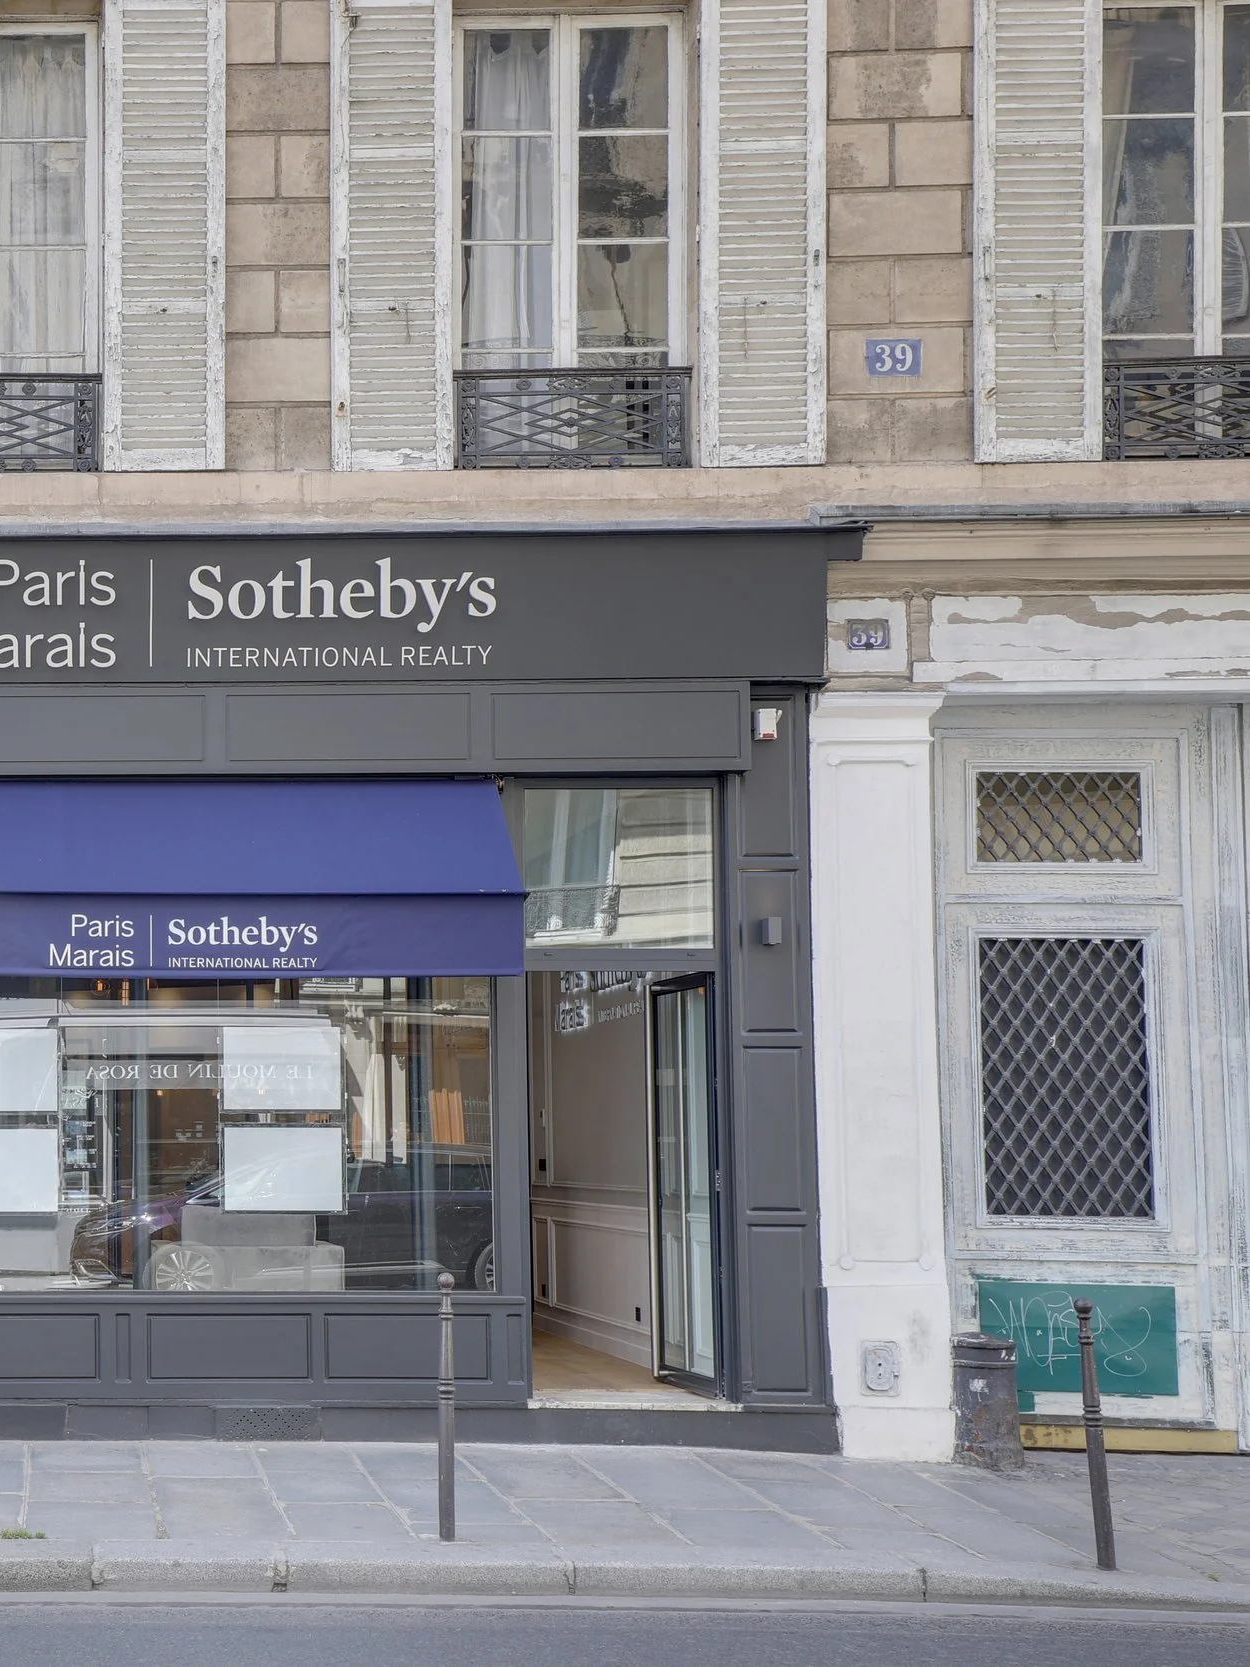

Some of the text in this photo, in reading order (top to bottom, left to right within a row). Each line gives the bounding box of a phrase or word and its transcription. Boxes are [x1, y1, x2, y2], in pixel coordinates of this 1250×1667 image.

[875, 343, 913, 372] 39
[187, 557, 497, 633] Sotheby's
[852, 623, 884, 646] 39
[186, 644, 493, 668] INTERNATIONAL REALTY
[70, 914, 135, 938] Paris
[167, 915, 319, 953] Sotheby's
[49, 943, 135, 967] Marais
[168, 957, 318, 969] INTERNATIONAL REALTY
